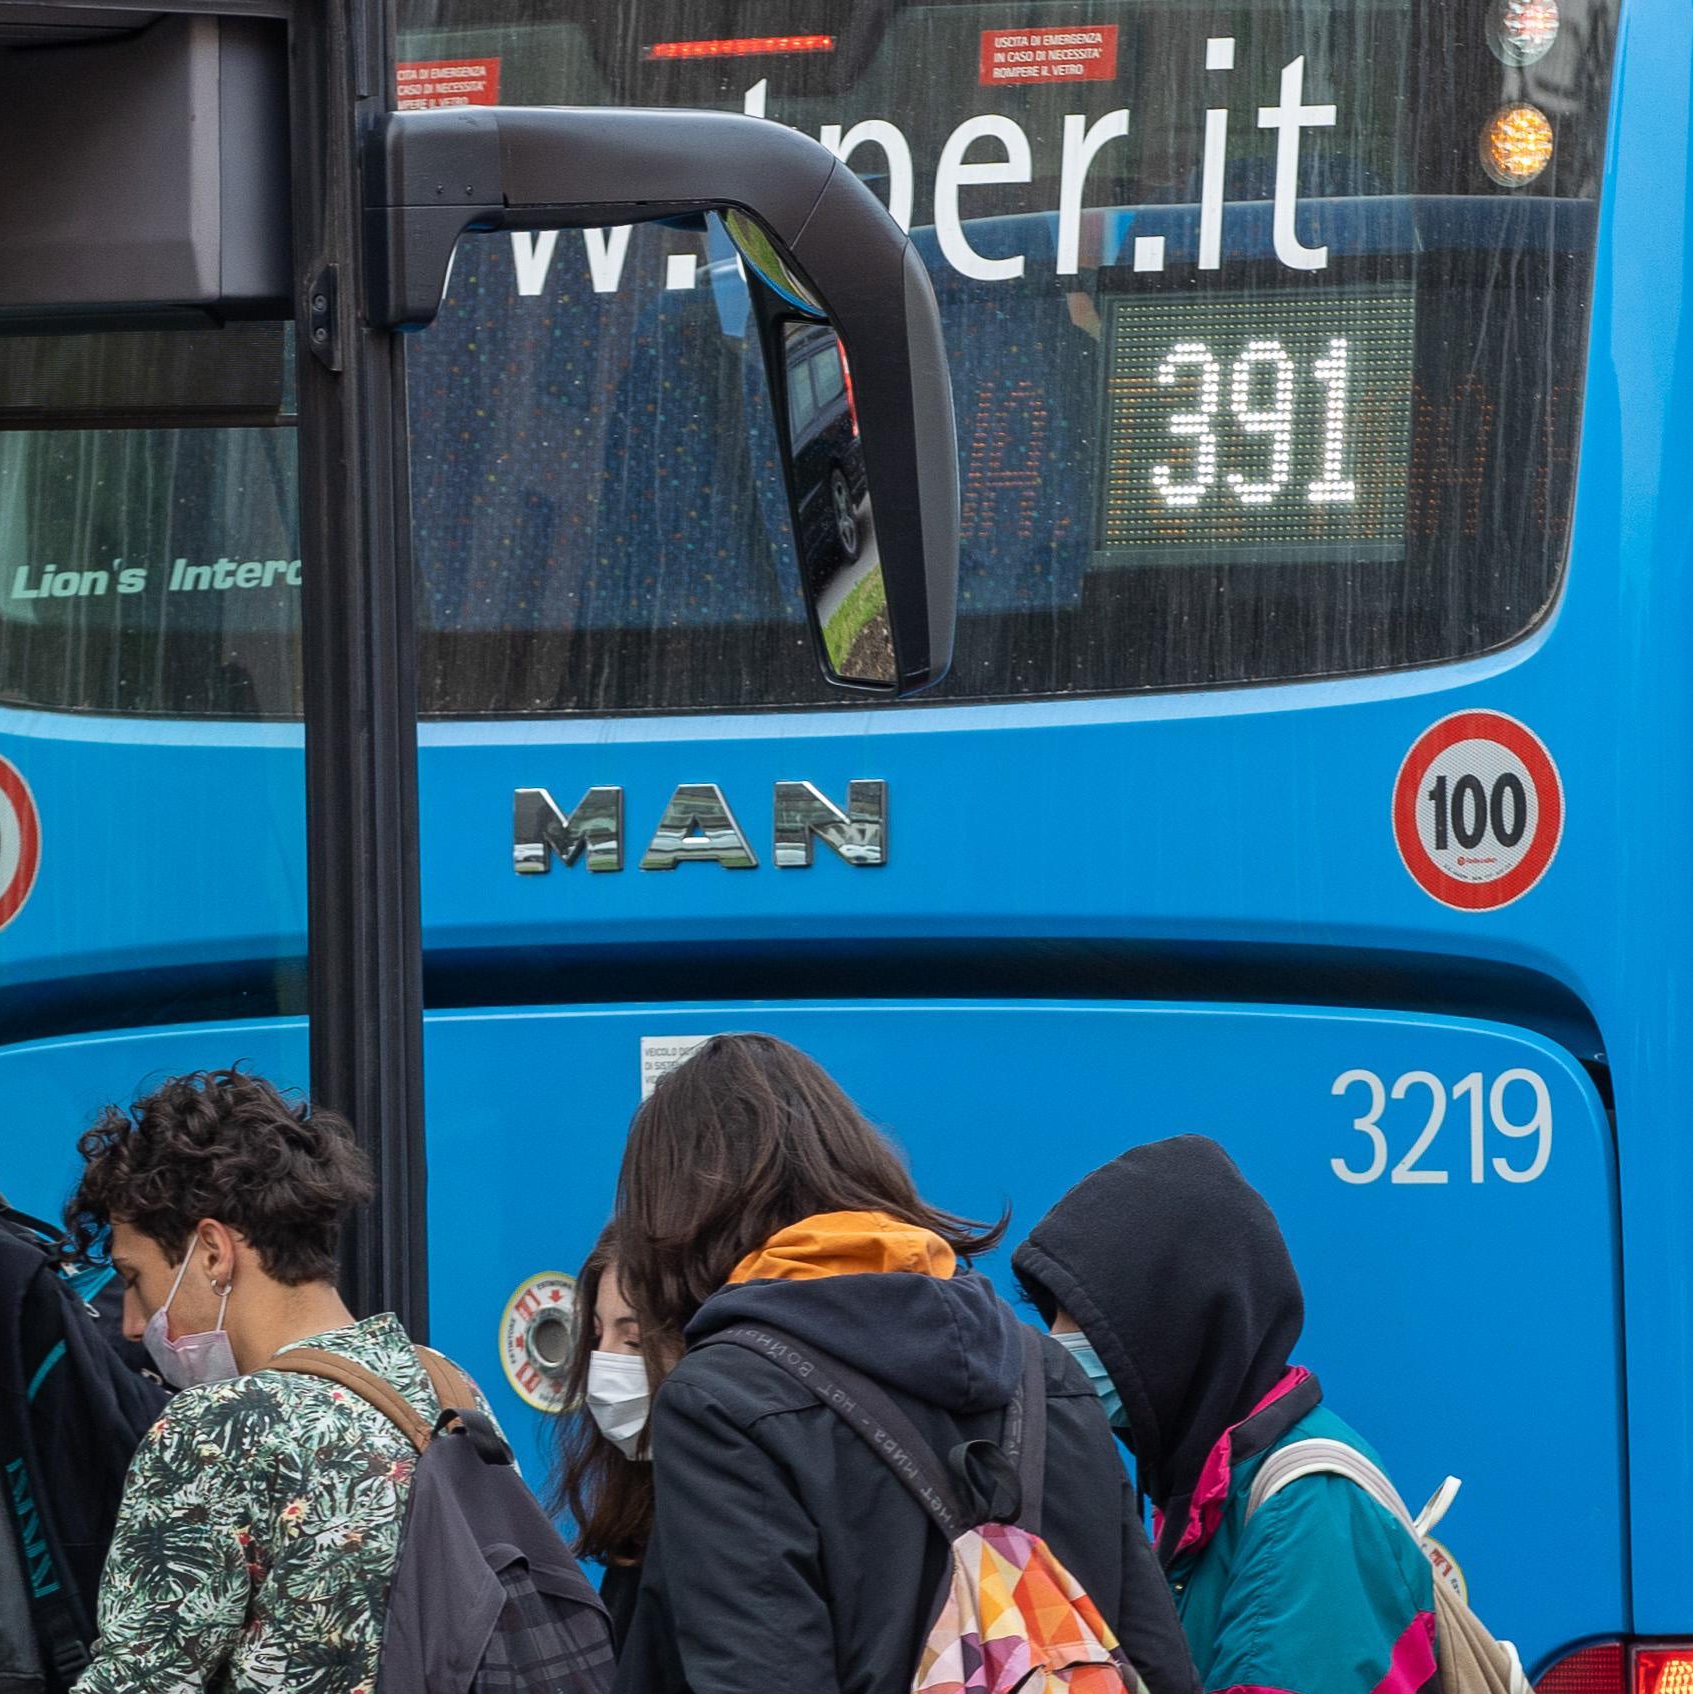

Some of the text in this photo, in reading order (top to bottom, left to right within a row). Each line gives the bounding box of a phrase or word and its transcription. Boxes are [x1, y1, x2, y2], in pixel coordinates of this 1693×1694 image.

[994, 36, 1028, 47] USCITA
[1043, 33, 1102, 45] EMERGENZA
[1007, 51, 1034, 62] CASO
[993, 66, 1039, 78] ROMPERE
[1052, 64, 1084, 75] VETRO
[1151, 338, 1357, 506] 391
[11, 557, 302, 599] Lion's Interc
[513, 779, 888, 874] MAN
[1428, 774, 1528, 851] 100
[1330, 1068, 1554, 1184] 3219
